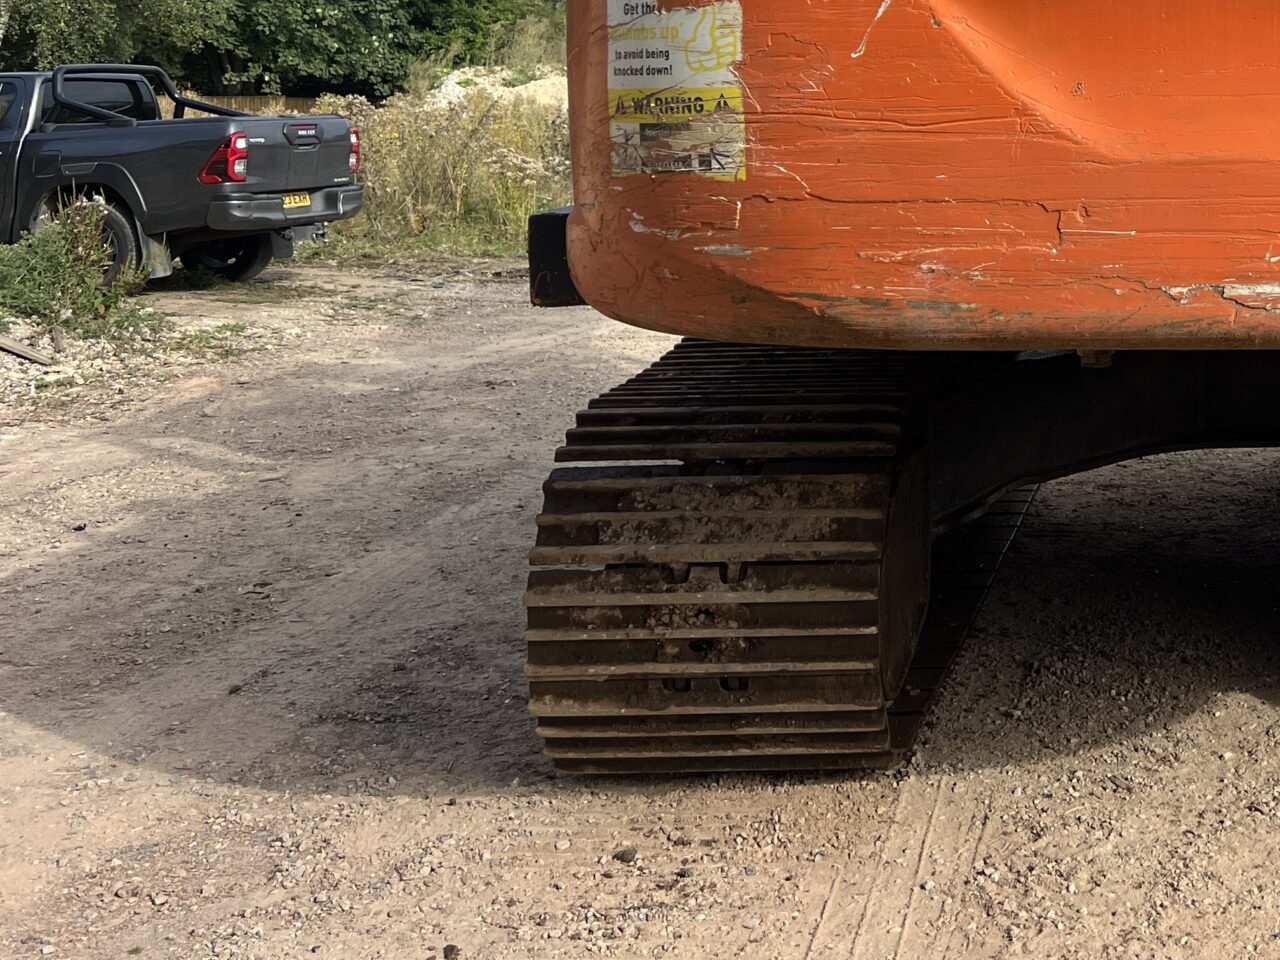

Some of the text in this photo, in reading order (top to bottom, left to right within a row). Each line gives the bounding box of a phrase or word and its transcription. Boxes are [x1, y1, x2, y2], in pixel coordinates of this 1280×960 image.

[623, 2, 639, 15] Get
[615, 48, 670, 61] to avoid being
[613, 65, 673, 76] knocked down!
[631, 96, 705, 115] WARNING
